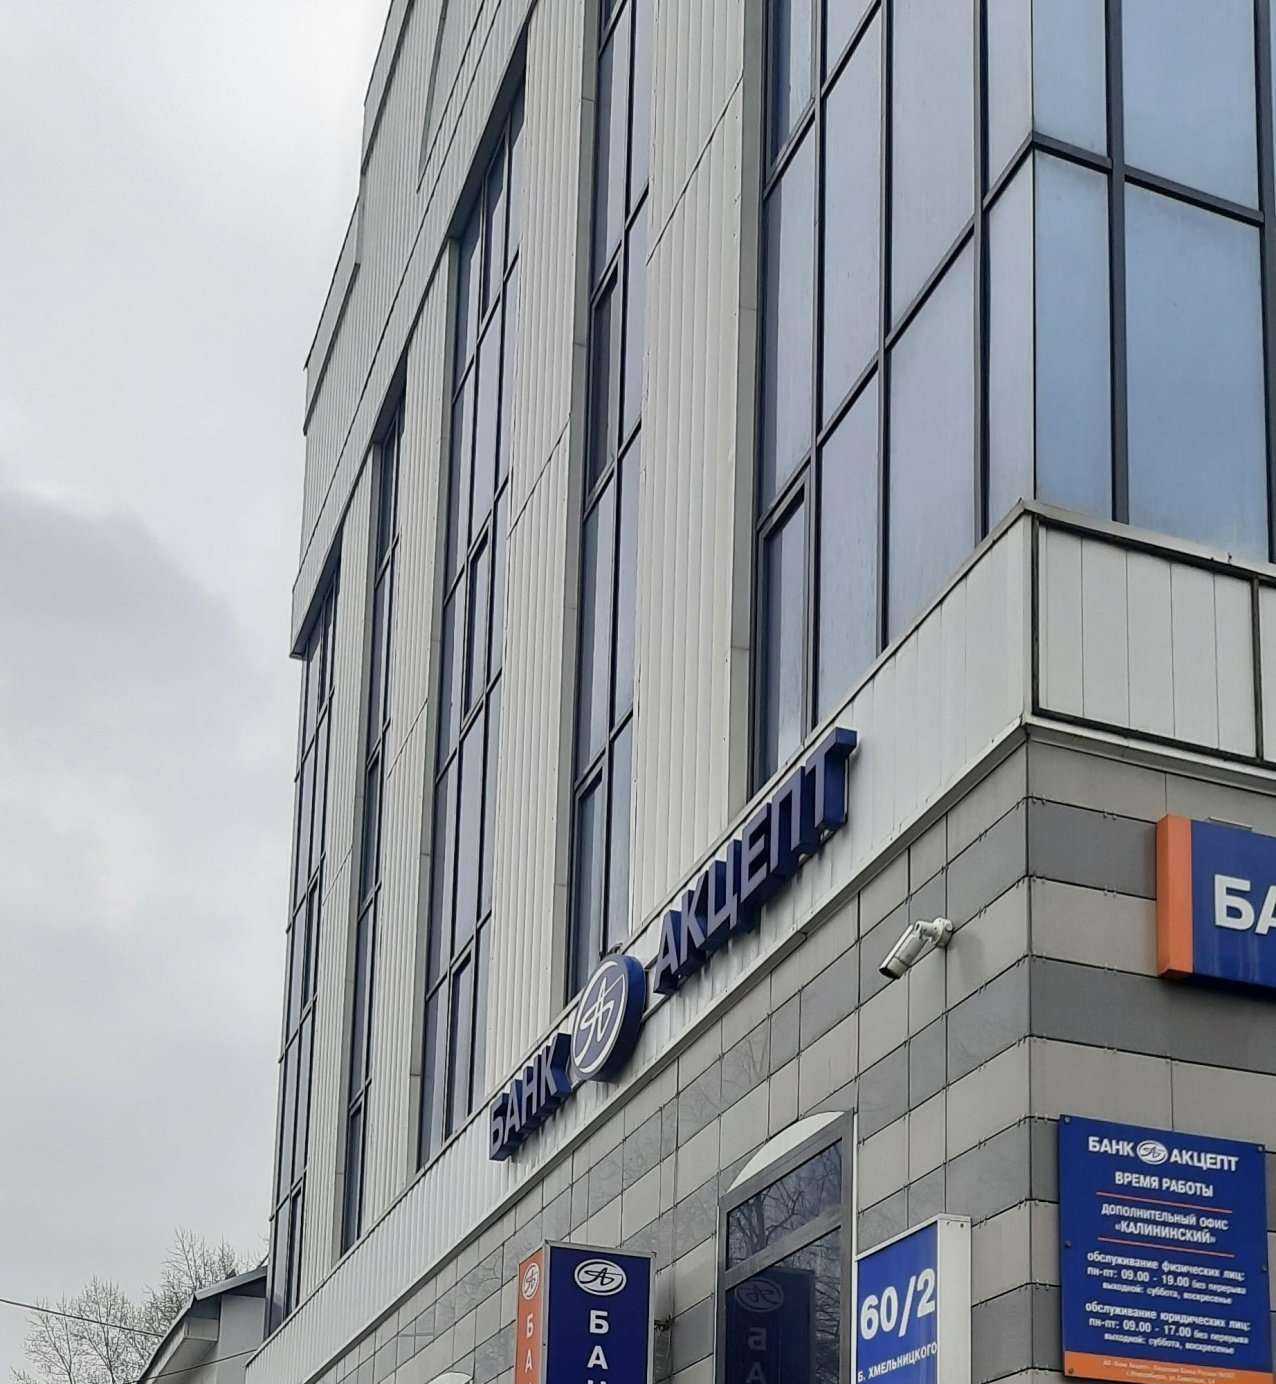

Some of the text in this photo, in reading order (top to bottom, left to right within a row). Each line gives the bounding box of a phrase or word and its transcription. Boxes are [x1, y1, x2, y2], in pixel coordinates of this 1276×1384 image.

[489, 728, 857, 1160] БАНК АКЦЕПТ
[1088, 1136, 1239, 1171] БАНК АКЦЕПТ
[1115, 1171, 1214, 1197] ВРЕМЯ РАБОТЫ
[1101, 1203, 1229, 1230] ДОПОЛНИТЕЛЬНЫЙ ОФИС
[1115, 1220, 1216, 1244] «КАЛИНИНСКИЙ»
[1087, 1251, 1159, 1270] обслуживание
[1161, 1260, 1221, 1278] физических
[1087, 1266, 1118, 1278] пн-пт:
[1121, 1269, 1150, 1282] 09.00
[1161, 1275, 1190, 1288] 19.00
[860, 1268, 936, 1340] 60/2
[1085, 1301, 1158, 1319] обслуживание
[1160, 1310, 1226, 1328] юридических
[1089, 1317, 1120, 1330] пн-пт:
[1123, 1320, 1151, 1333] 09.00
[1164, 1325, 1192, 1338] 17.00
[857, 1341, 938, 1383] Б. ХМЕЛЬНИЦКОГО
